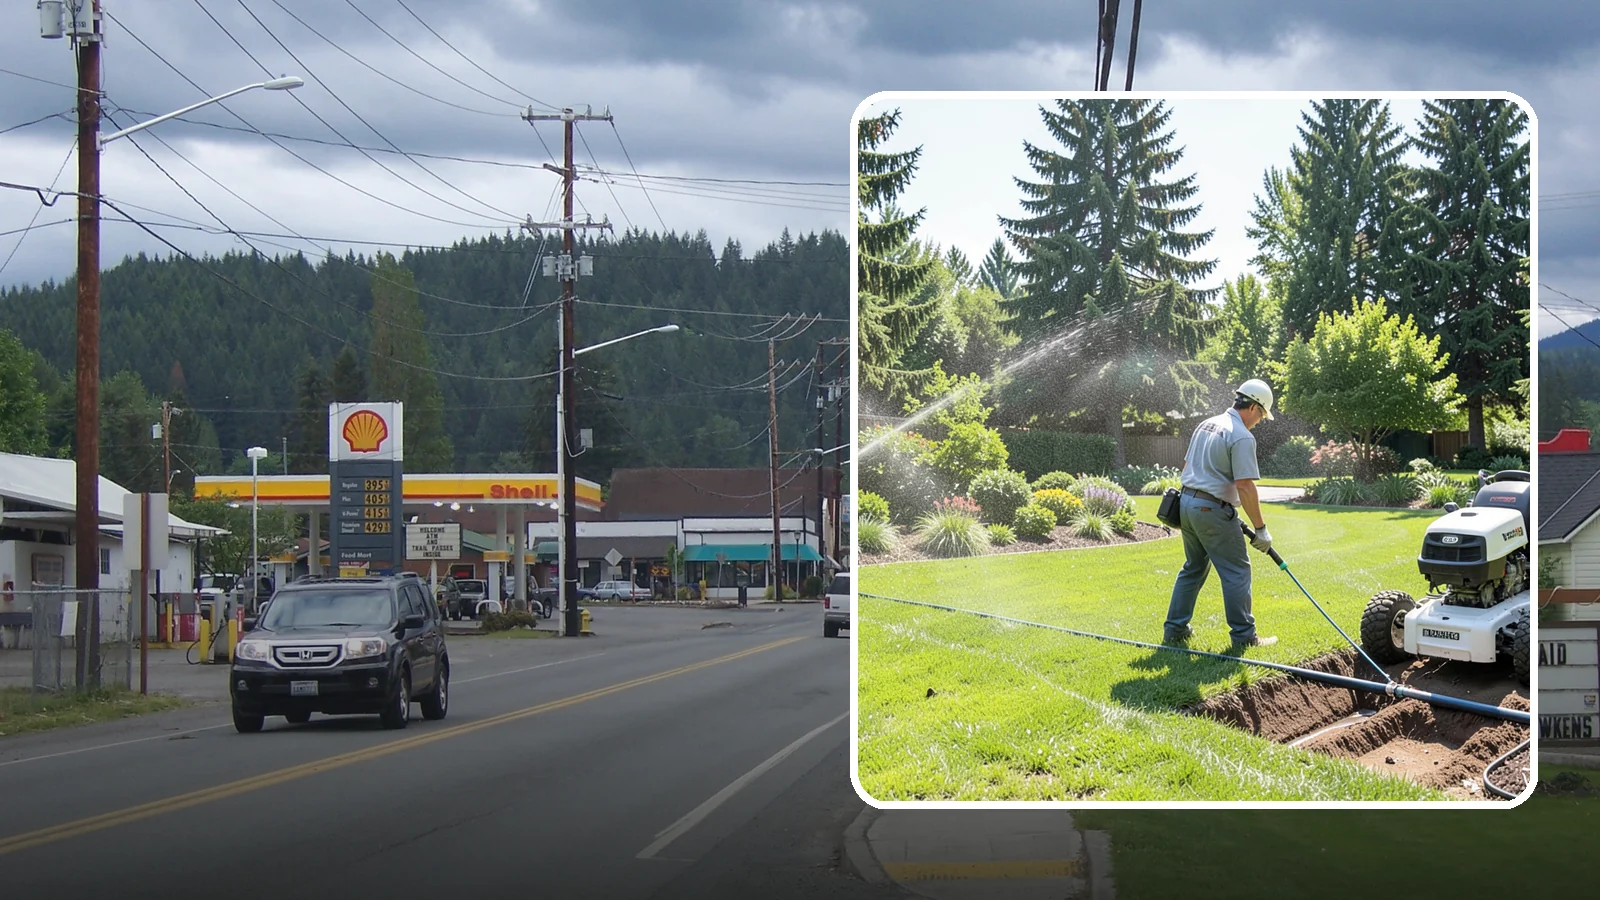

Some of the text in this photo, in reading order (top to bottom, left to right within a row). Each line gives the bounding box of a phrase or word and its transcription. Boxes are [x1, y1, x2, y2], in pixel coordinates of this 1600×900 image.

[365, 480, 384, 490] 395
[490, 484, 547, 499] Shell
[365, 494, 384, 504] 405
[365, 508, 384, 518] 415
[366, 522, 384, 532] 429
[1538, 643, 1566, 665] AID
